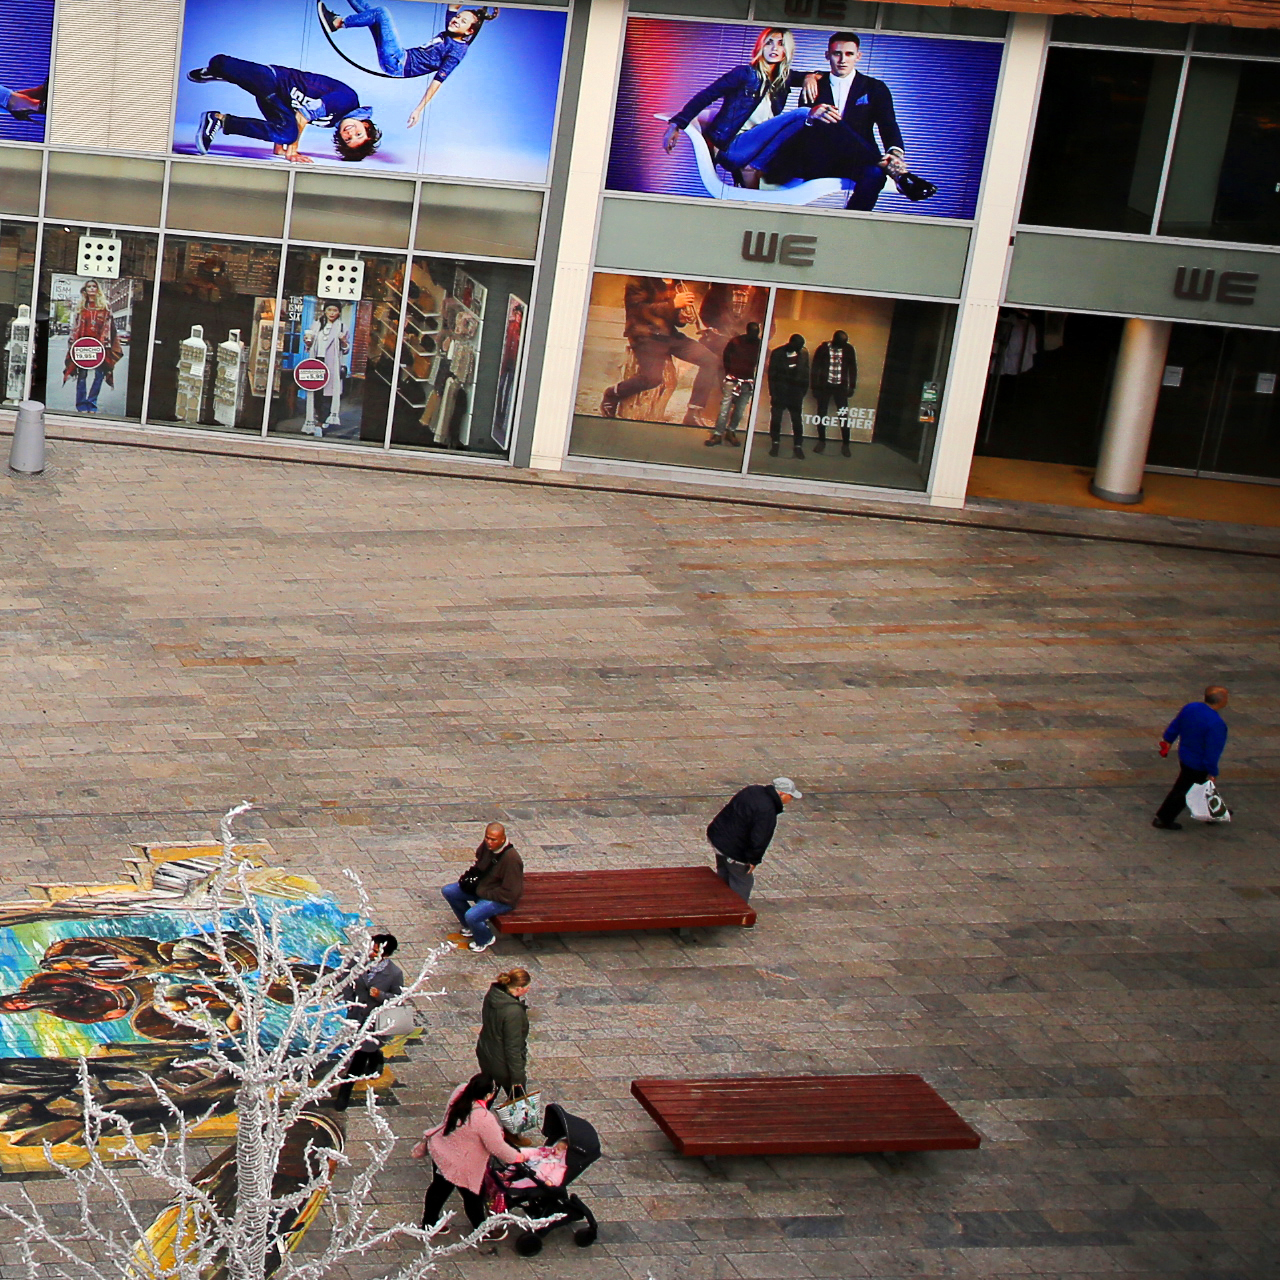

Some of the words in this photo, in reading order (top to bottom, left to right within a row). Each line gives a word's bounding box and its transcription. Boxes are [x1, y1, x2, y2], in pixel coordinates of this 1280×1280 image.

[741, 230, 818, 266] WE
[83, 263, 113, 273] SIX
[324, 285, 355, 295] SIX
[1173, 266, 1260, 306] WE
[288, 311, 302, 321] SIX
[836, 406, 876, 419] #GET
[803, 414, 874, 430] TOGETHER
